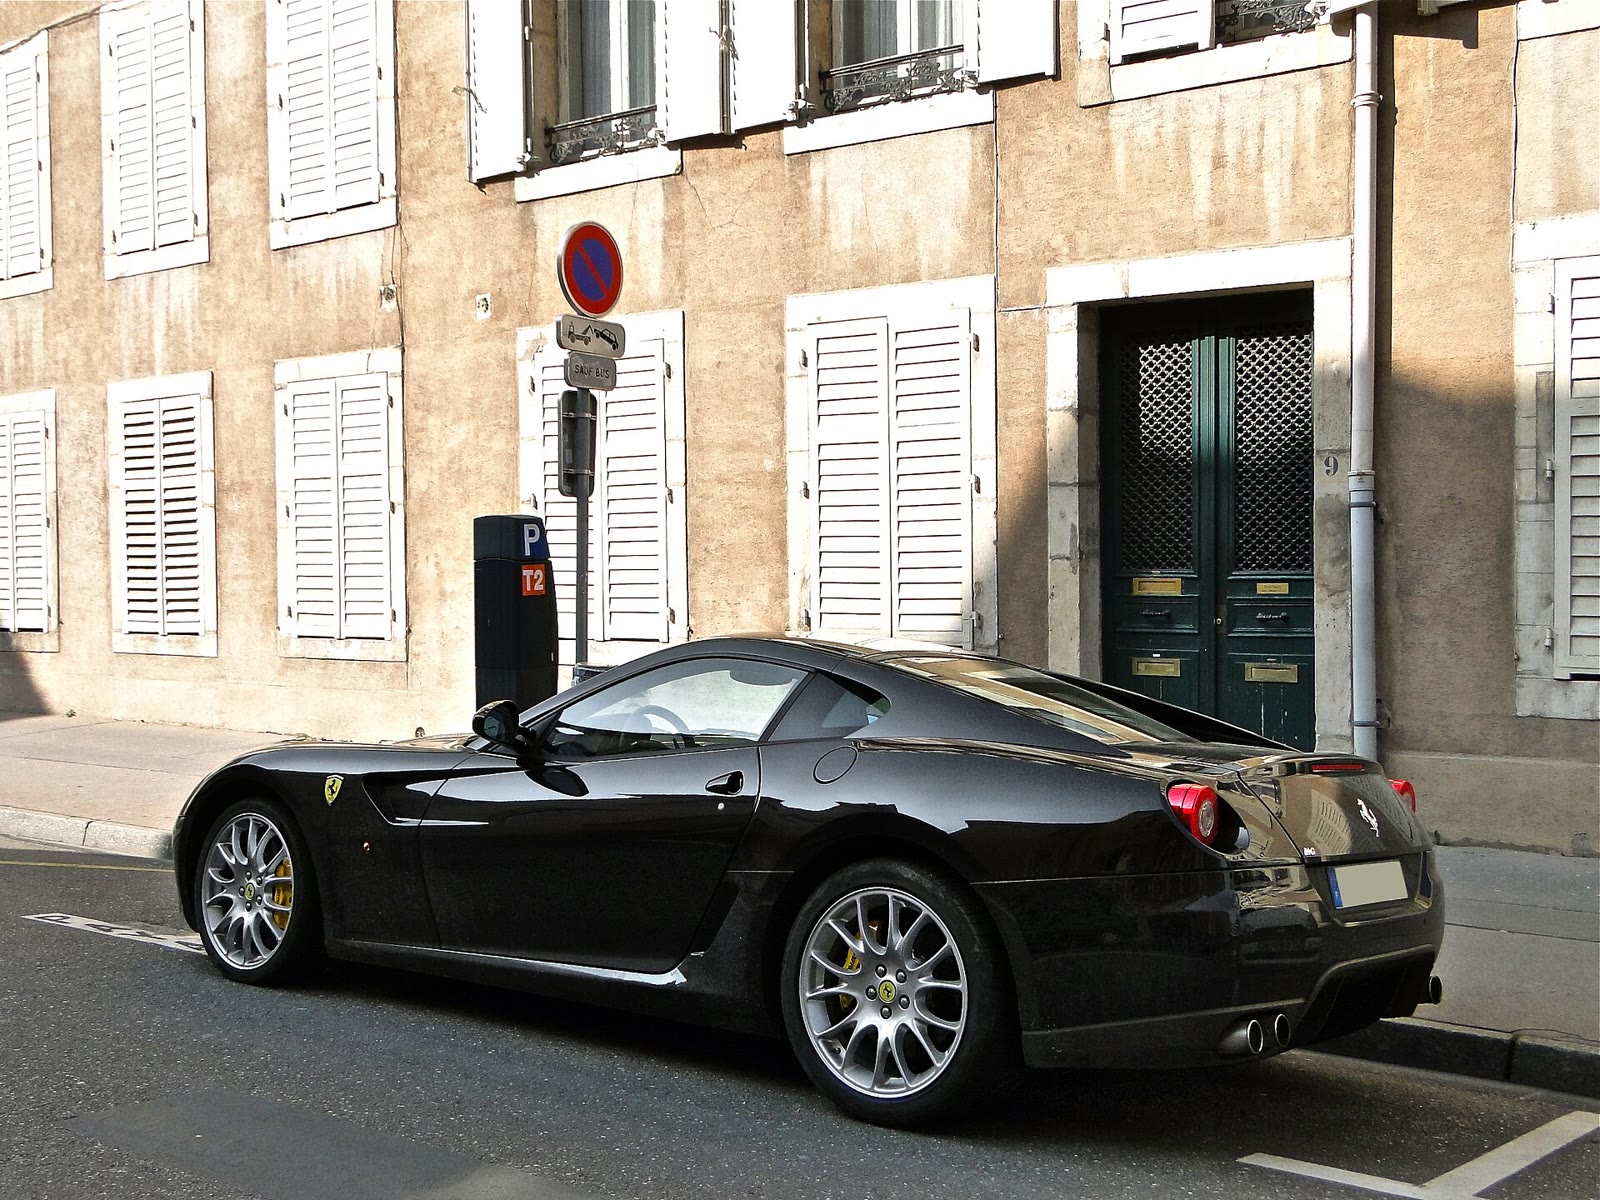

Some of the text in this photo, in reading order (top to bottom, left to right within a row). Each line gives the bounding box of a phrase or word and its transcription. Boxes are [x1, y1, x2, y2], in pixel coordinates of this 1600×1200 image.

[574, 364, 610, 379] SAUF BUS
[1324, 456, 1339, 477] 9
[523, 523, 541, 556] P
[522, 569, 544, 591] T2
